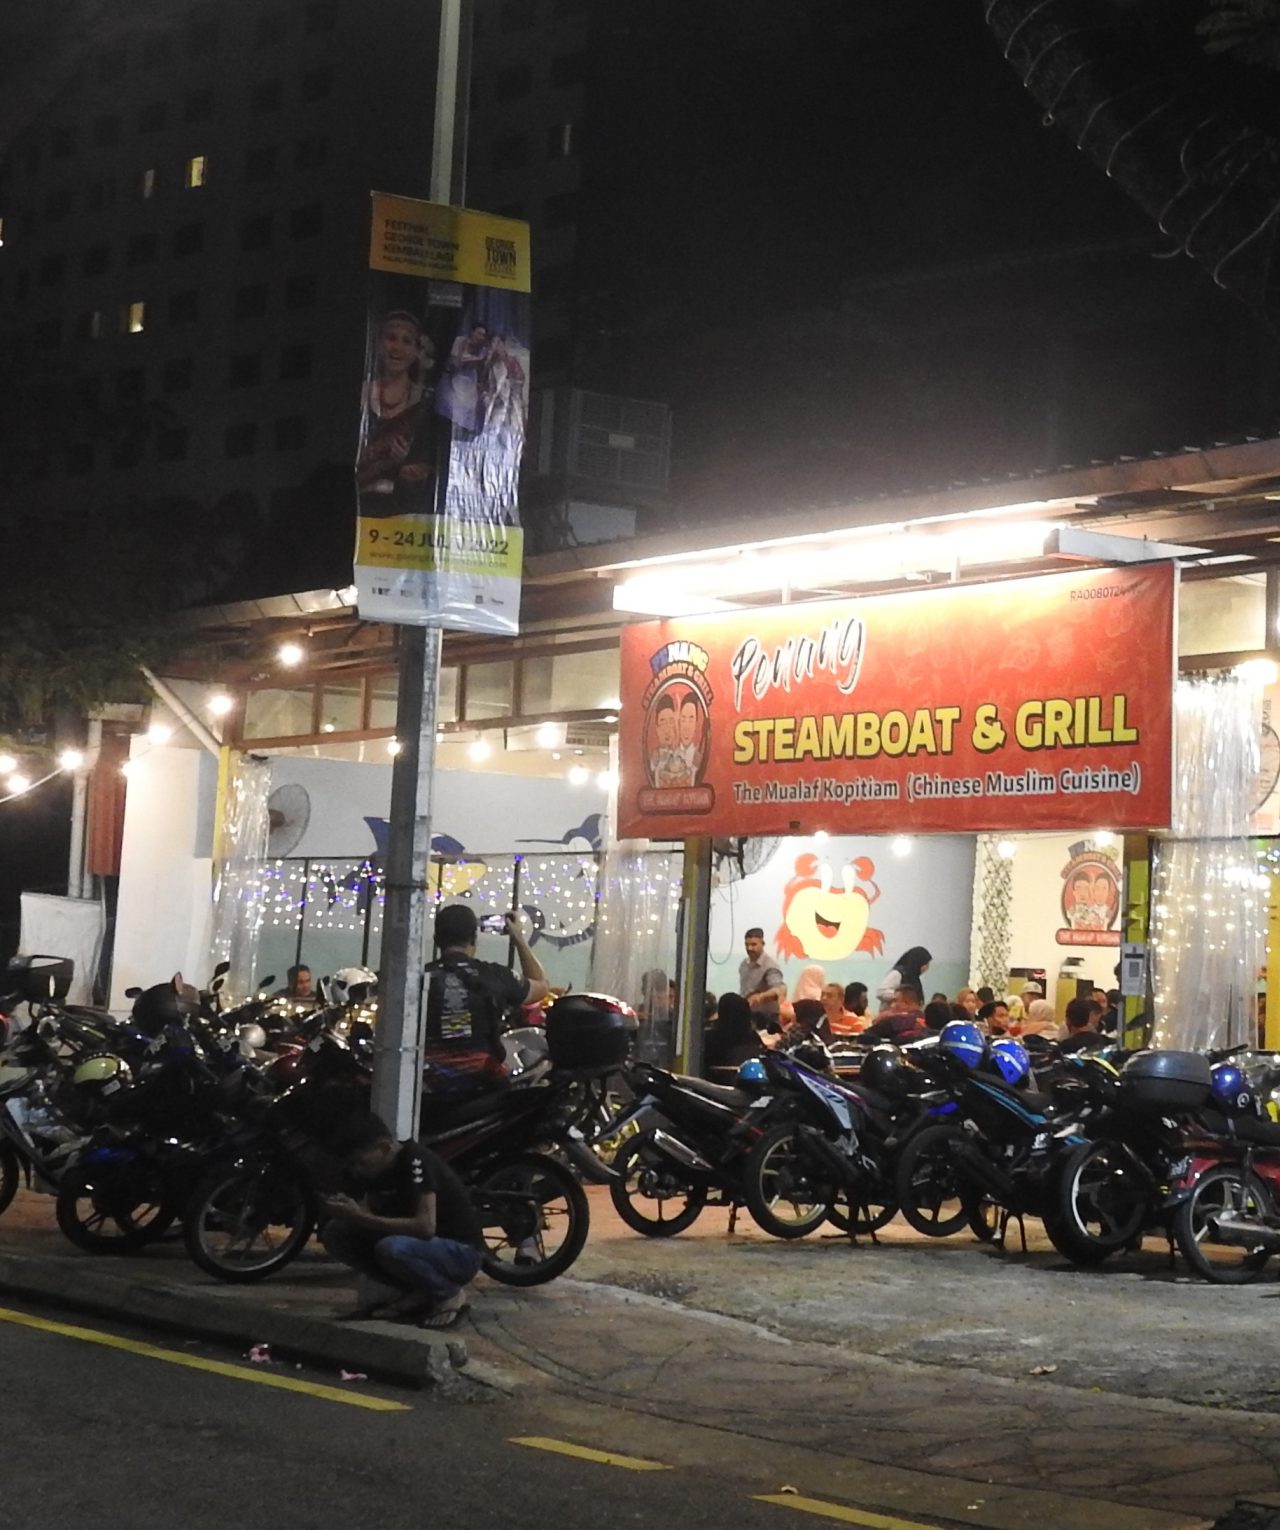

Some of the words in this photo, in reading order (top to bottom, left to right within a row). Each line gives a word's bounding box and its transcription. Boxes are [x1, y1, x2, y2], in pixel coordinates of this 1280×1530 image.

[384, 231, 424, 246] GEORGE
[427, 238, 459, 251] TOWN
[486, 248, 517, 266] TOWN
[369, 529, 379, 543] 9
[393, 530, 415, 546] 24
[732, 617, 863, 712] Penang
[733, 706, 961, 765] STEAMBOAT
[971, 703, 1007, 753] &
[1014, 694, 1139, 749] GRILL
[734, 780, 761, 802] The
[764, 777, 820, 802] Mualaf
[823, 775, 899, 805] Kopitiam
[907, 771, 982, 803] (Chinese
[986, 768, 1055, 796] Muslim
[1060, 761, 1140, 796] Cuisine)
